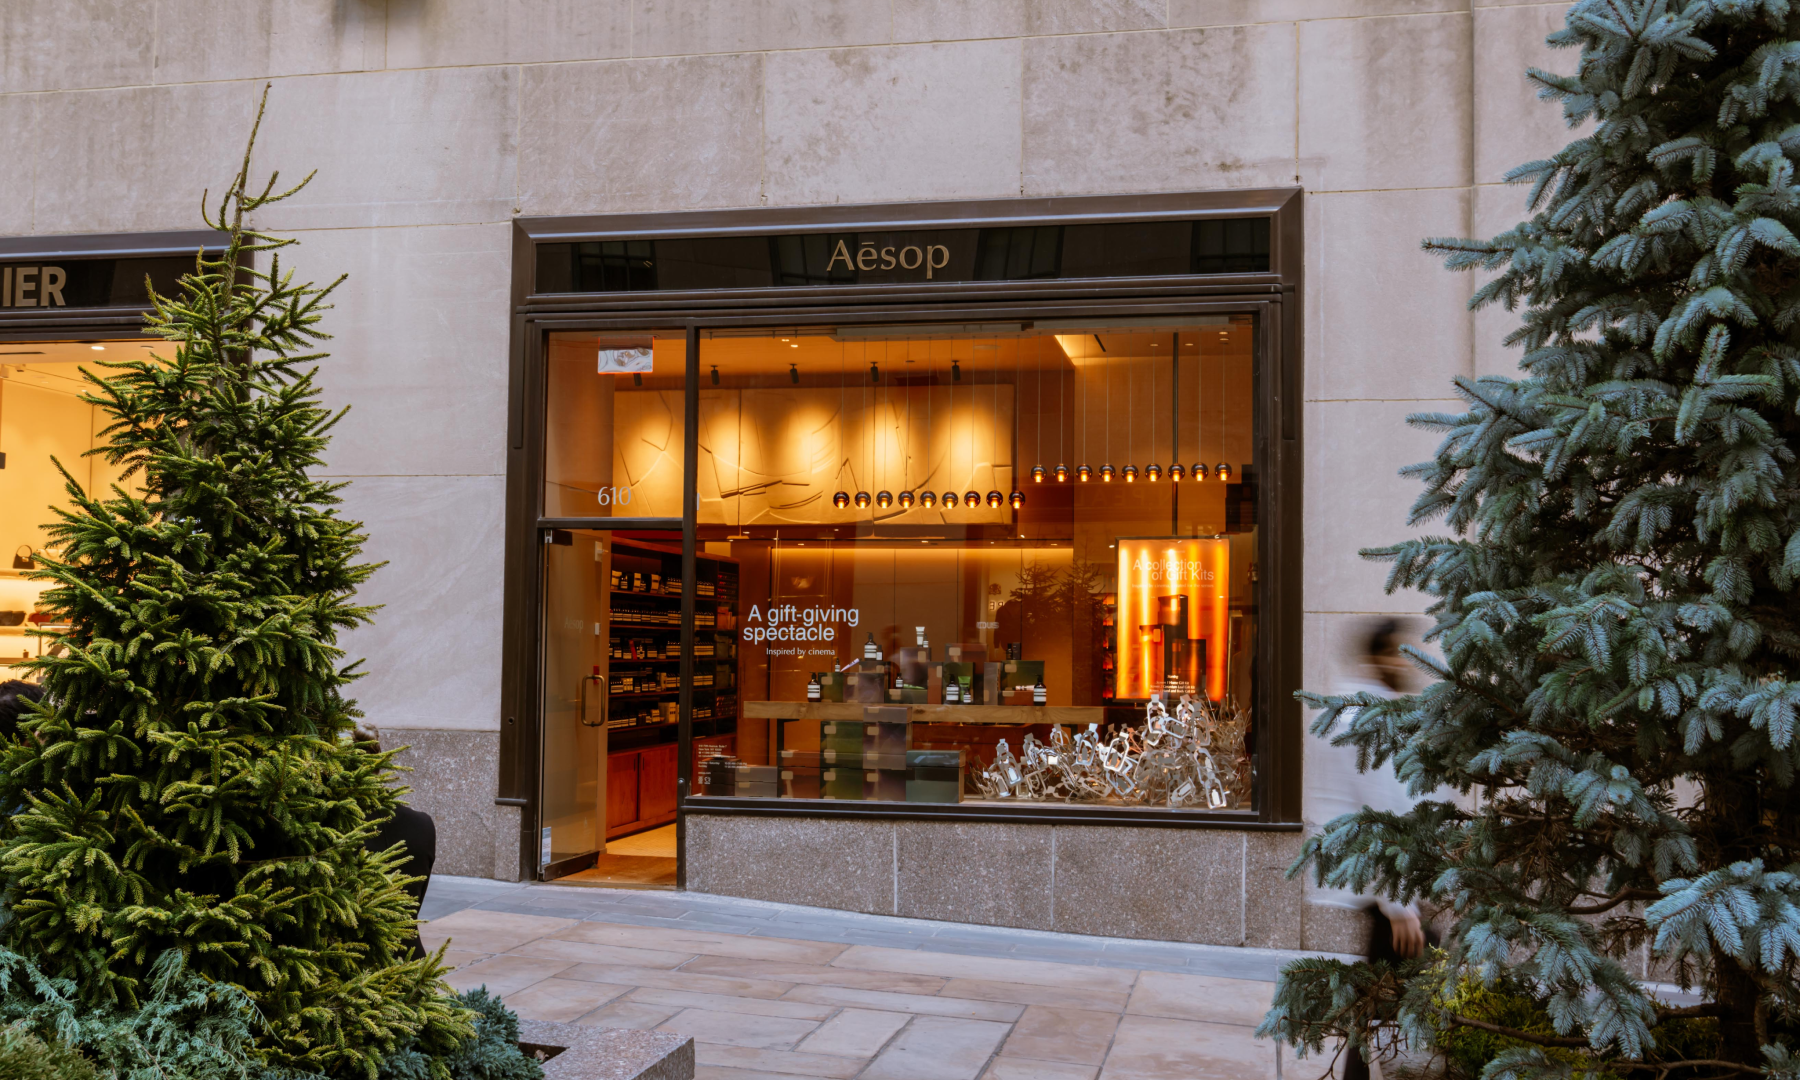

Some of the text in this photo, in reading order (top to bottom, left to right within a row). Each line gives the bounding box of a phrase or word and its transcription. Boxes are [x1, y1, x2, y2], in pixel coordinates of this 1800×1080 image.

[826, 239, 950, 279] Aēsop
[2, 266, 67, 307] IER
[597, 486, 632, 506] 610
[1133, 558, 1202, 571] A collection
[1151, 568, 1215, 581] of Gift Kits
[747, 604, 859, 628] A gift-giving
[743, 623, 835, 645] spectacle
[766, 647, 836, 658] Inspired by cinema
